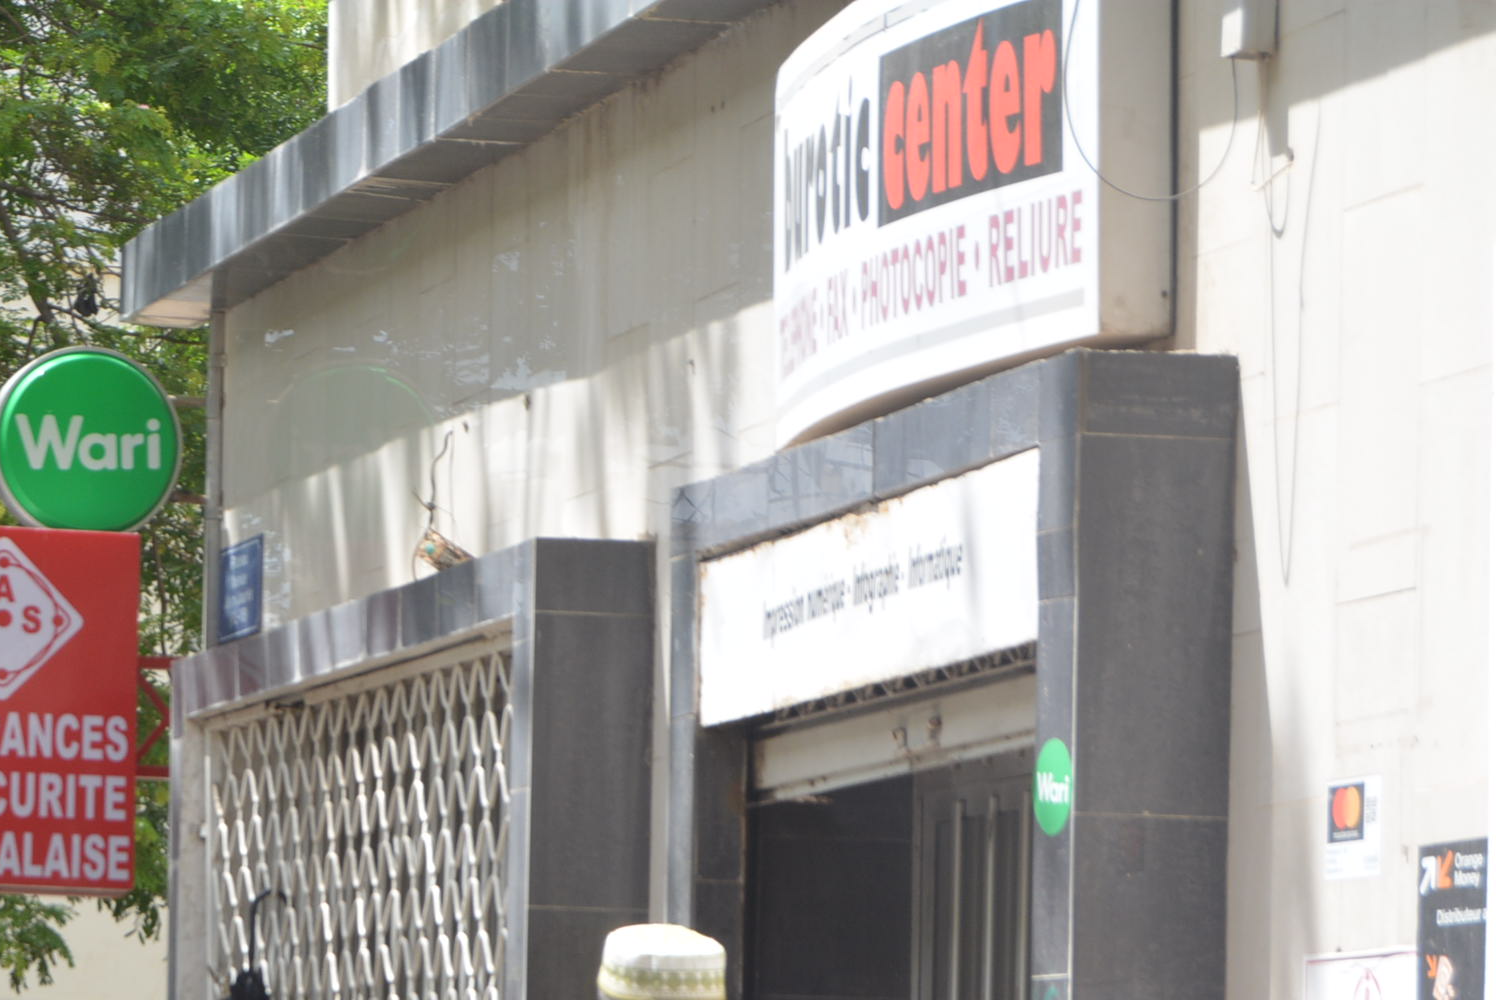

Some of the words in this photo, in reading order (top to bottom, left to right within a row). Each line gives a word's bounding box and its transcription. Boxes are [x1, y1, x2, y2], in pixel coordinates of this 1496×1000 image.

[783, 74, 870, 274] burotic
[883, 18, 1057, 211] center
[861, 224, 967, 330] PHOTOCOPIE
[989, 189, 1083, 288] RELIURE
[15, 413, 162, 472] Wari
[22, 605, 43, 634] S
[1036, 771, 1070, 804] Wari
[1455, 852, 1483, 870] Orange
[1454, 869, 1480, 888] Money
